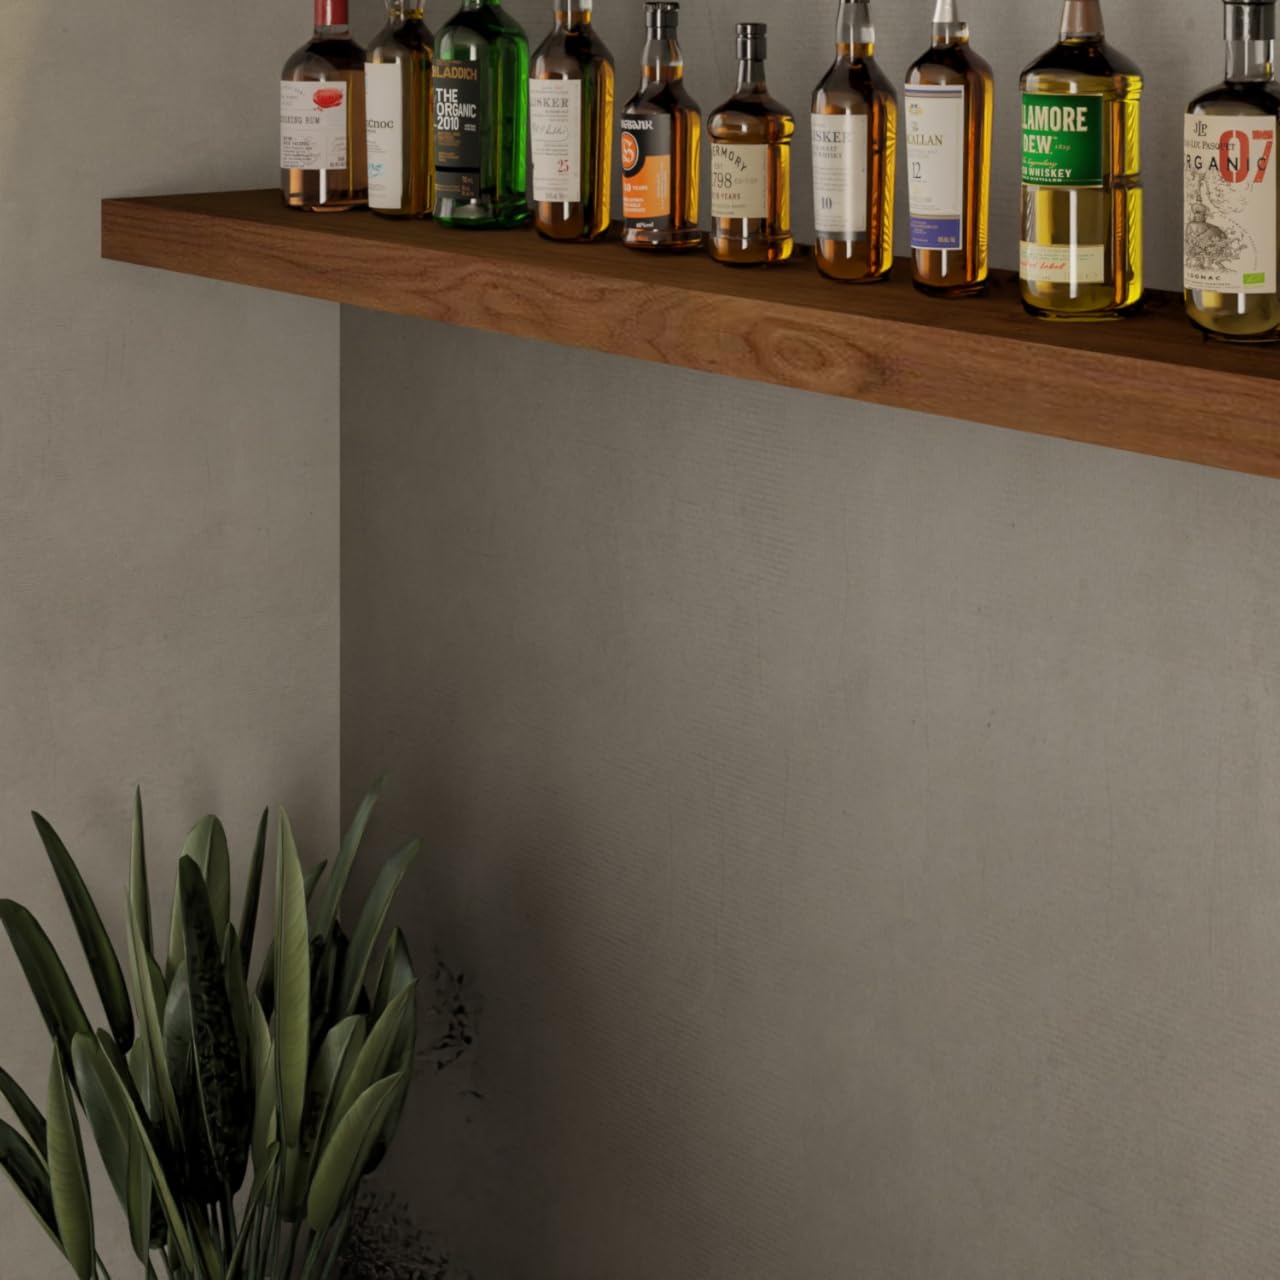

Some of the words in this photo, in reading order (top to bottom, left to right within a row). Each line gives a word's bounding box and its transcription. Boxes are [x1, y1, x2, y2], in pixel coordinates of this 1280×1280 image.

[435, 87, 459, 103] THE
[436, 102, 478, 119] ORGANIC
[437, 116, 460, 131] 2010
[1184, 154, 1267, 172] RGANIC
[1219, 129, 1274, 184] 07
[557, 159, 570, 173] 25
[911, 161, 922, 179] 12
[1028, 166, 1072, 179] WHISKEY
[820, 196, 833, 210] 10
